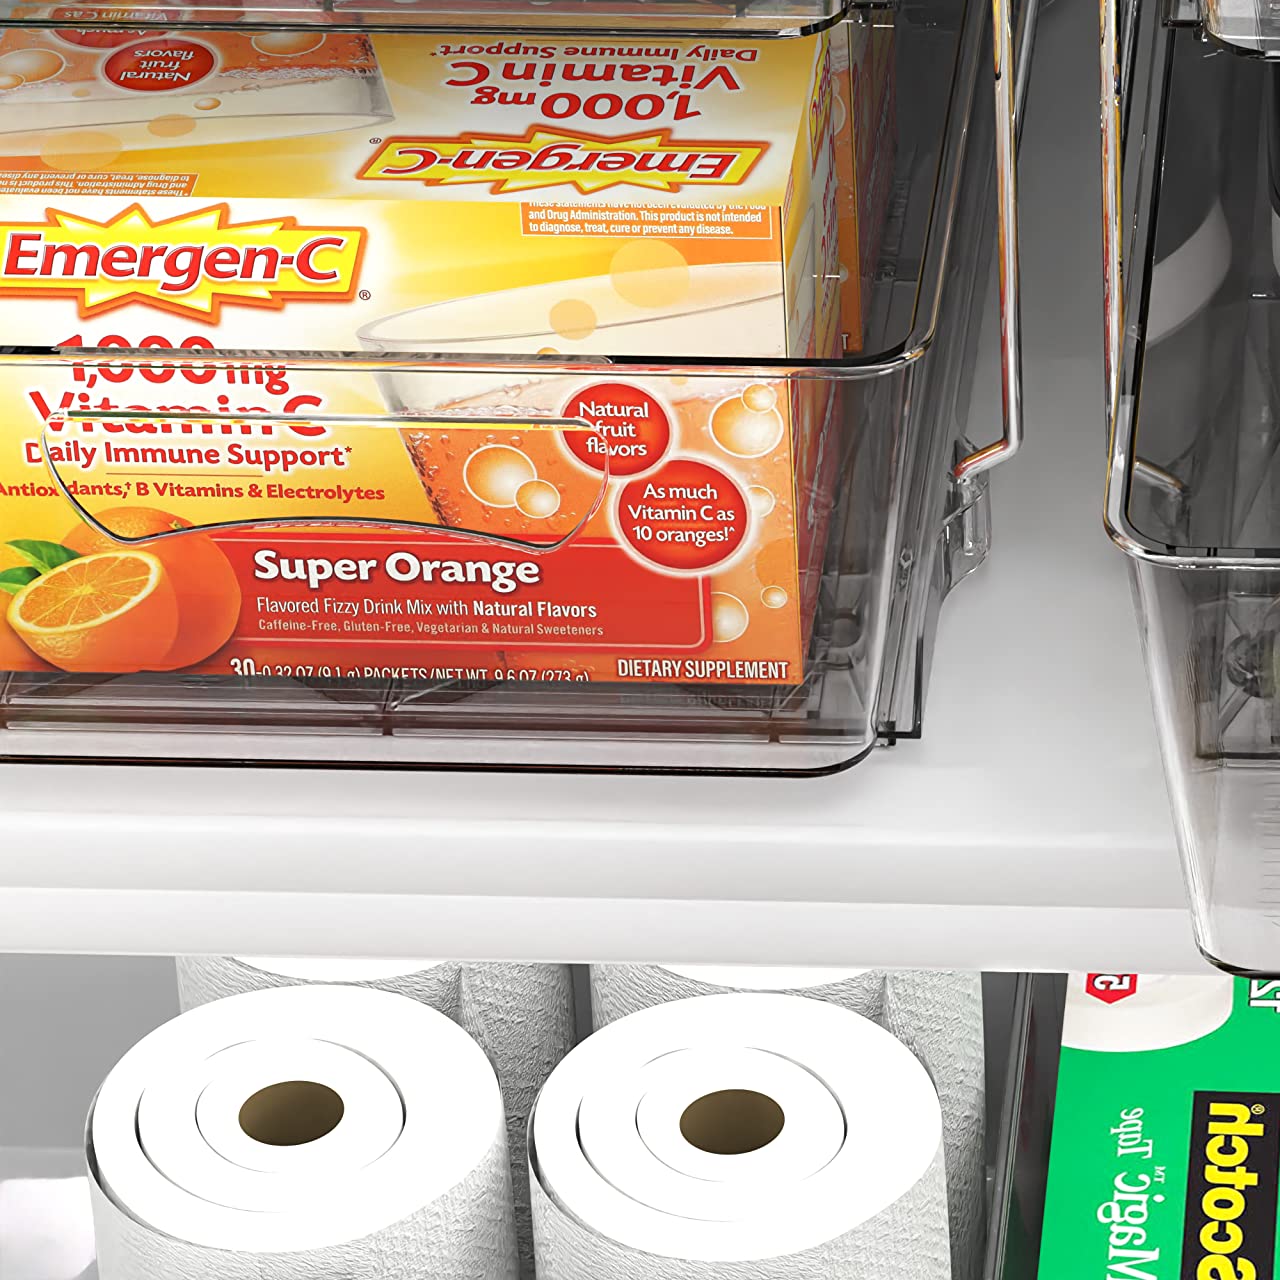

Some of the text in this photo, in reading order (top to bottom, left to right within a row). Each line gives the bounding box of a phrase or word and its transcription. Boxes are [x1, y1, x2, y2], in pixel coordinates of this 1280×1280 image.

[566, 46, 679, 61] Immune
[687, 44, 759, 62] Daily
[445, 62, 742, 91] Vitamin C
[470, 86, 703, 122] 1,000 mg
[381, 144, 740, 180] Emergen-C
[528, 210, 762, 225] and Drug Administration. This product is not intended
[4, 232, 344, 292] Emergen-C
[578, 401, 649, 418] Natural
[595, 420, 636, 438] fruit
[26, 441, 97, 472] Daily
[105, 442, 221, 465] Immune
[585, 437, 647, 457] flavors
[136, 483, 149, 496] B
[157, 481, 243, 499] Vitamins
[248, 485, 263, 498] &
[266, 484, 385, 503] Electrolytes
[643, 484, 718, 500] As much
[627, 504, 735, 521] Vitamin C as
[632, 526, 652, 541] 10
[254, 548, 541, 594] Super Orange
[257, 596, 597, 618] Flavored Fizzy Drink Mix with Natural Flavors
[259, 619, 604, 636] Caffeine-Free, Gluten-Free, Vegetarian & Natural Sweeteners
[617, 658, 681, 680] DIETARY
[686, 660, 788, 681] SUPPLEMENT
